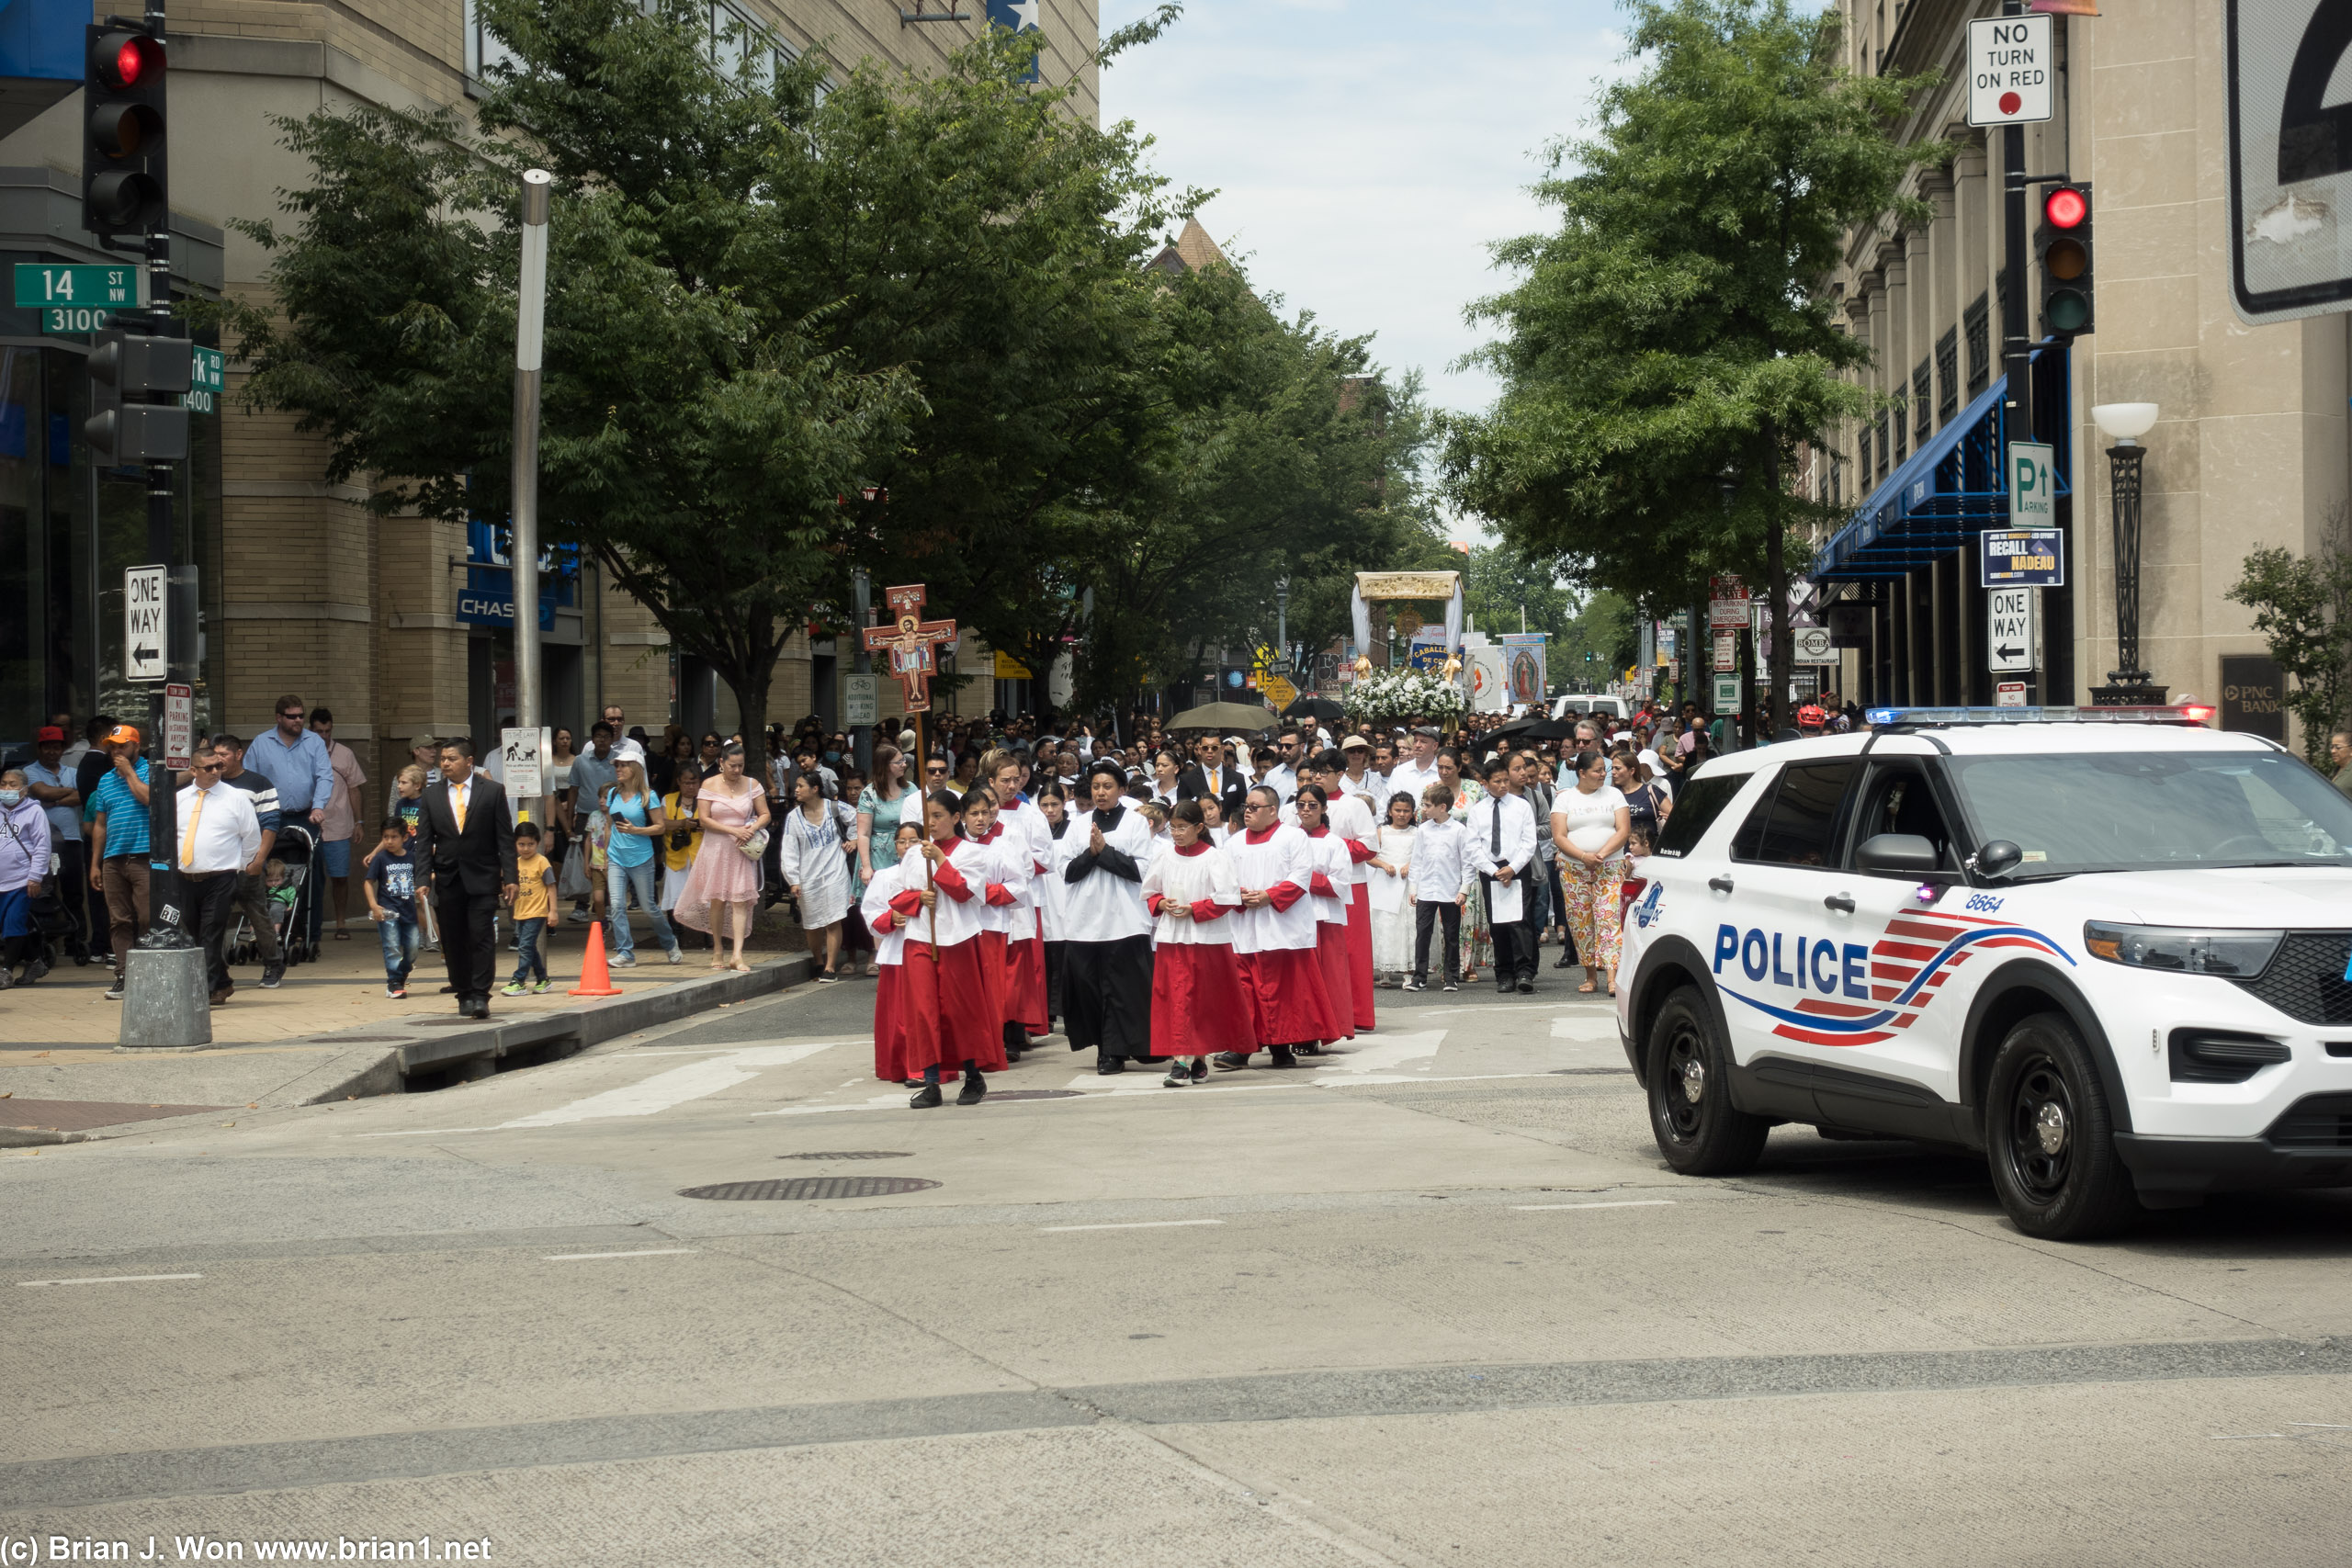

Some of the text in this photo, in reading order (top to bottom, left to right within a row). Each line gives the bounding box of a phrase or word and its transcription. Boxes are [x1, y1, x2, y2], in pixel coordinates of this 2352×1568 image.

[1994, 24, 2028, 45] NO
[1987, 49, 2034, 66] TURN
[1977, 70, 2044, 89] ON RED
[42, 270, 74, 300] 14
[108, 272, 124, 285] ST
[109, 288, 125, 301] NW
[51, 309, 107, 331] 3100
[210, 355, 220, 369] RD
[210, 371, 220, 386] NW
[1989, 540, 2029, 557] RECALL
[2011, 555, 2055, 570] NADEAU
[130, 576, 160, 603] ONE
[461, 599, 514, 617] CHAS
[1995, 593, 2025, 614] ONE
[130, 607, 161, 634] WAY
[1994, 617, 2026, 637] WAY
[1797, 639, 1830, 648] BOMBA
[1414, 647, 1463, 661] CABALLES
[2240, 686, 2274, 698] PNC
[175, 699, 183, 709] NO
[2242, 700, 2281, 713] BANK
[169, 711, 189, 723] PARKING
[170, 734, 188, 743] ANYTIME
[401, 807, 419, 815] NEXT
[1965, 894, 2005, 913] 8664
[1713, 924, 1869, 1000] POLICE
